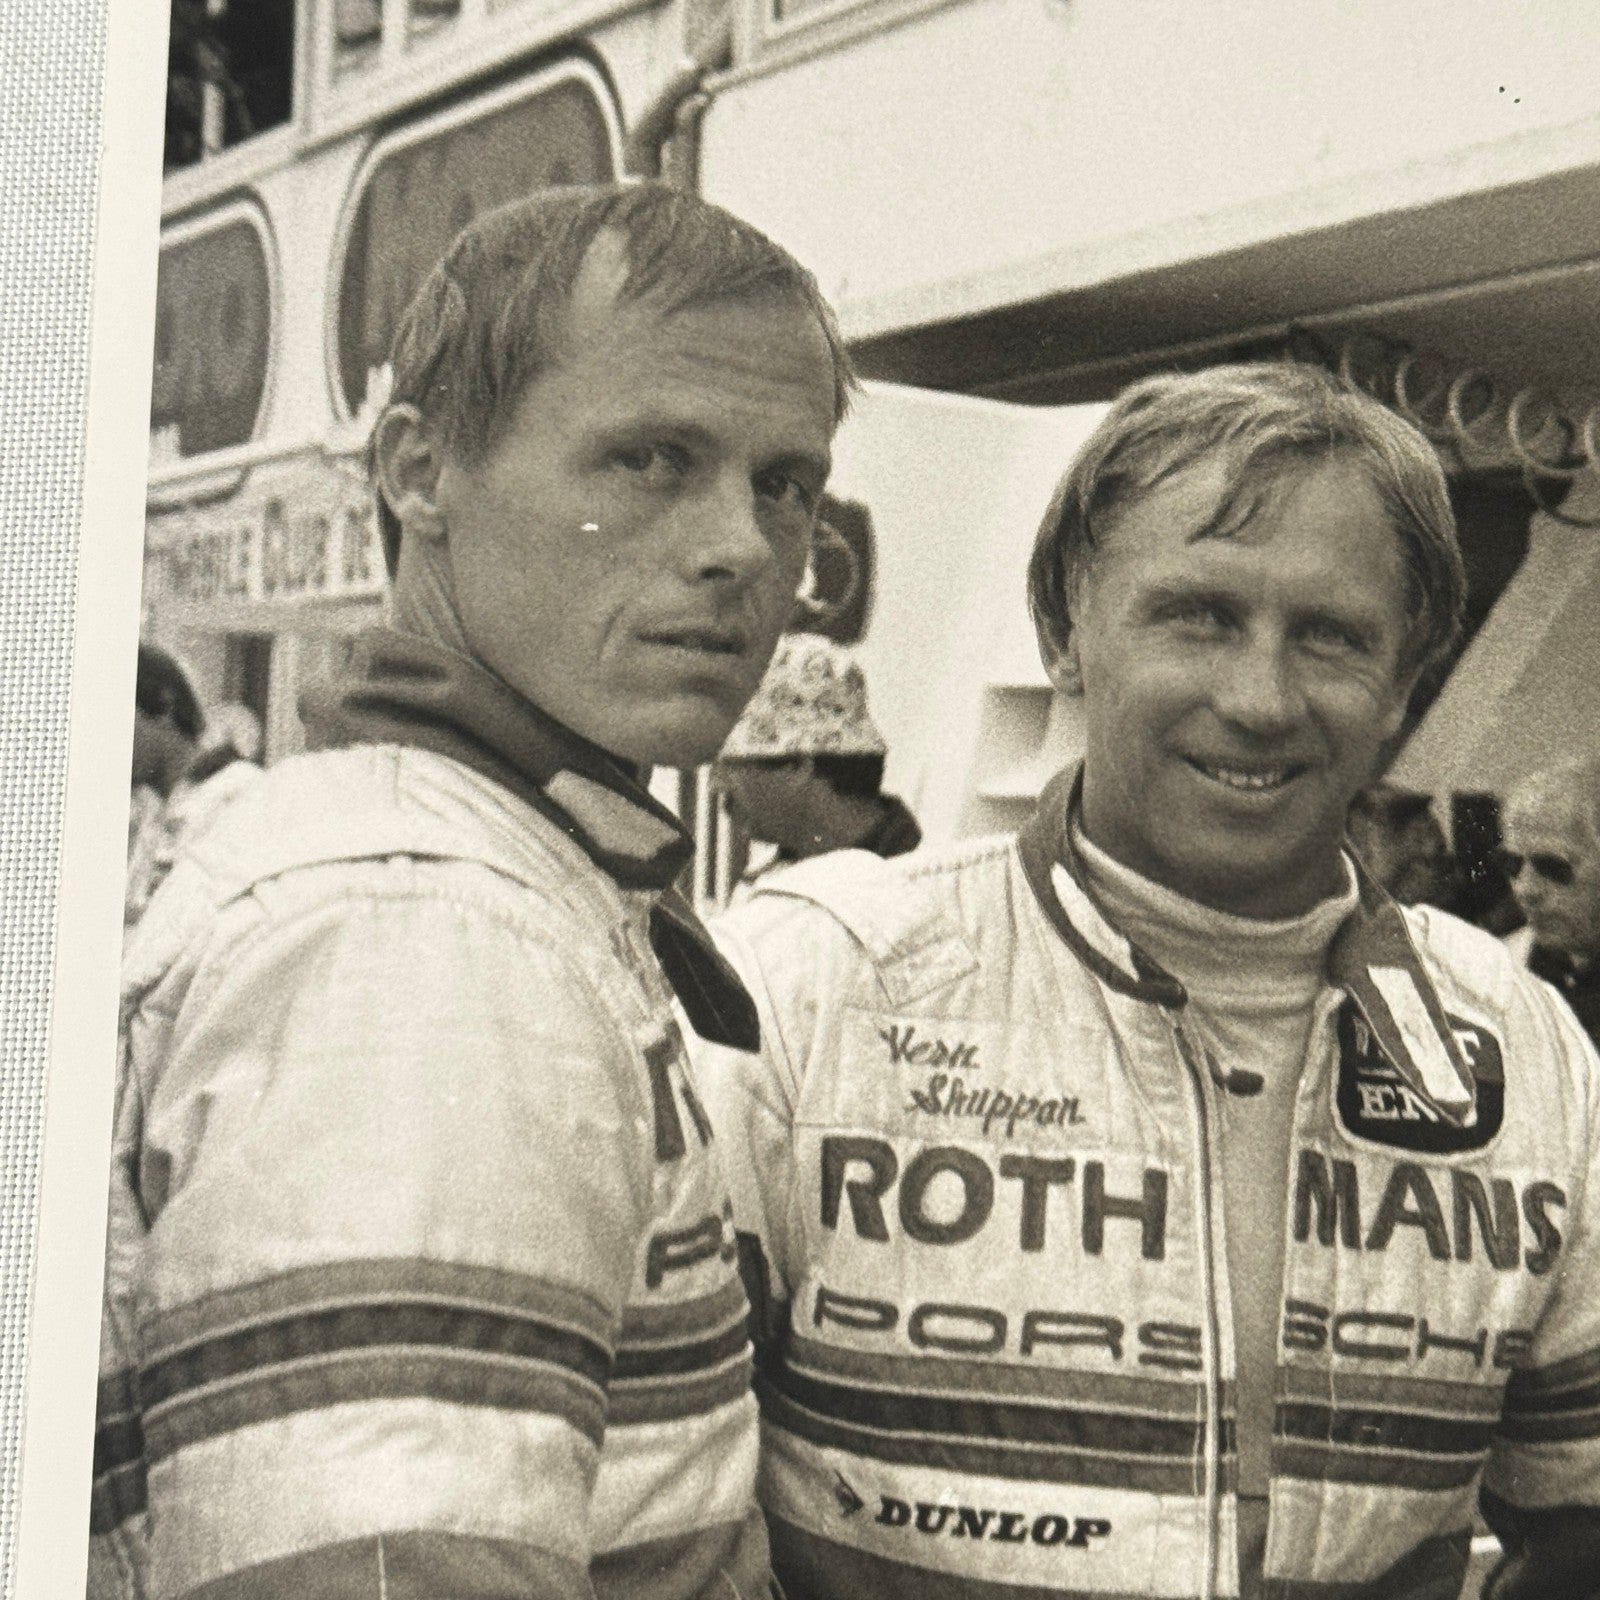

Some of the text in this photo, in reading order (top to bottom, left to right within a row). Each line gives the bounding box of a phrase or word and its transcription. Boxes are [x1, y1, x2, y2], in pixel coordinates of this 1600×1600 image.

[820, 1136, 1566, 1276] ROTH MANS
[874, 1495, 1112, 1549] DUNLOP
